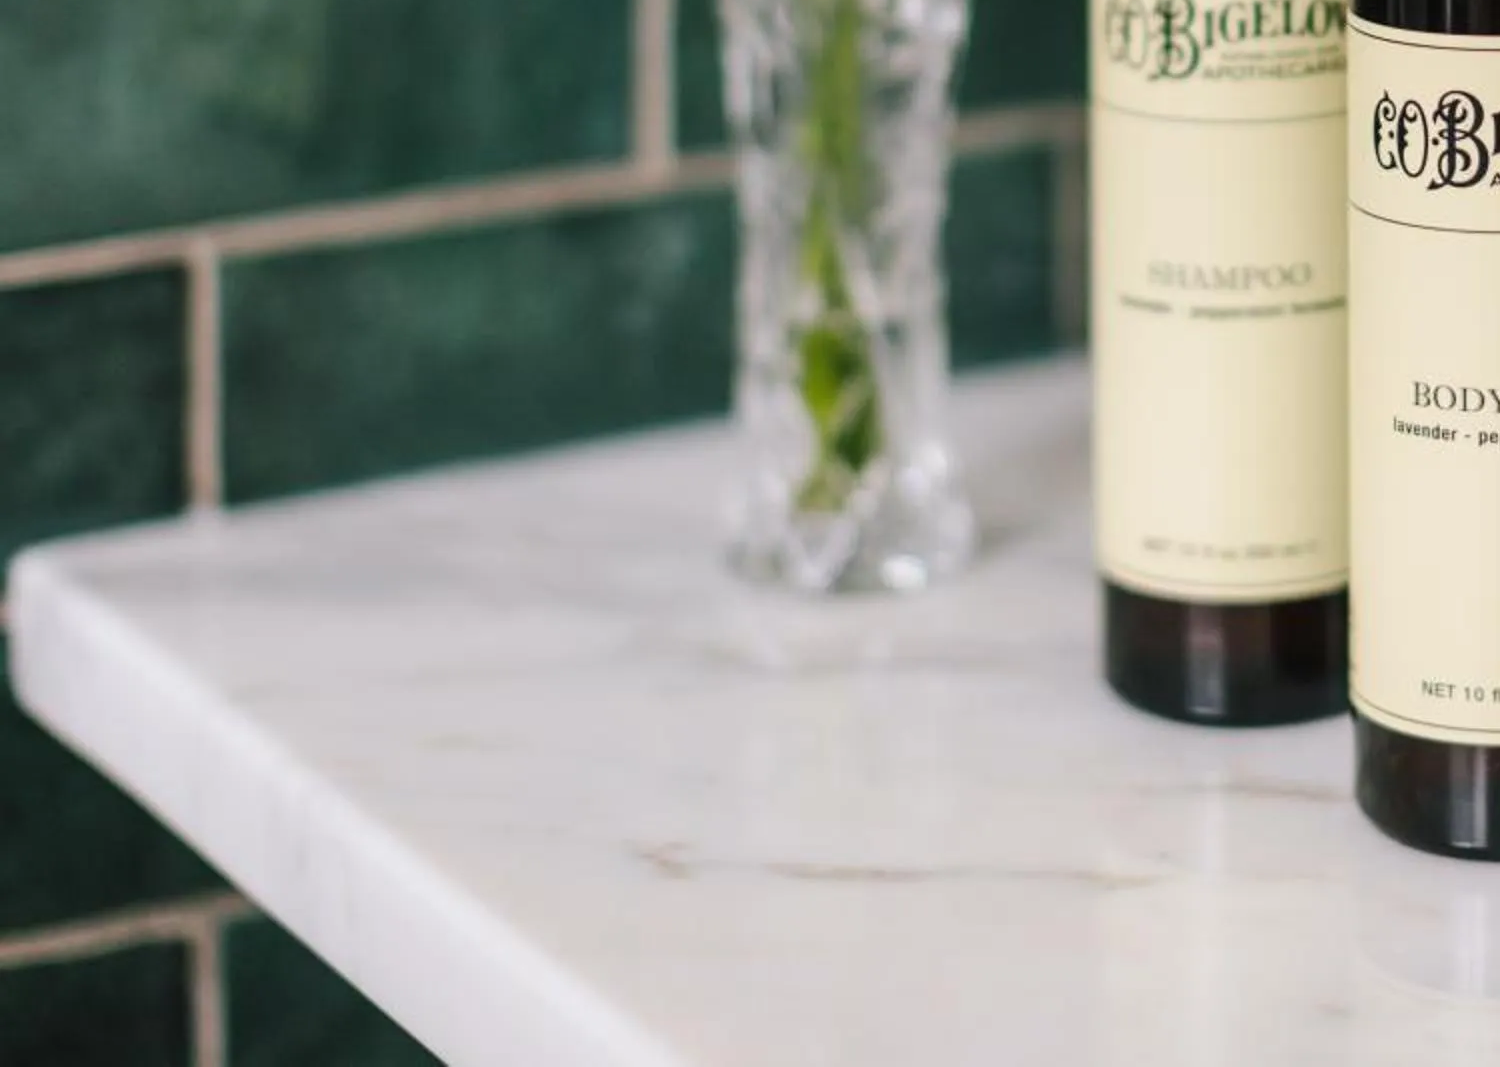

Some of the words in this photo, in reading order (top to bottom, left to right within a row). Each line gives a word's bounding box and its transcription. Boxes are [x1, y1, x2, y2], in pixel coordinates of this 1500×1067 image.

[1393, 417, 1457, 441] lavender
[1421, 681, 1455, 698] NET
[1464, 686, 1485, 701] 10
